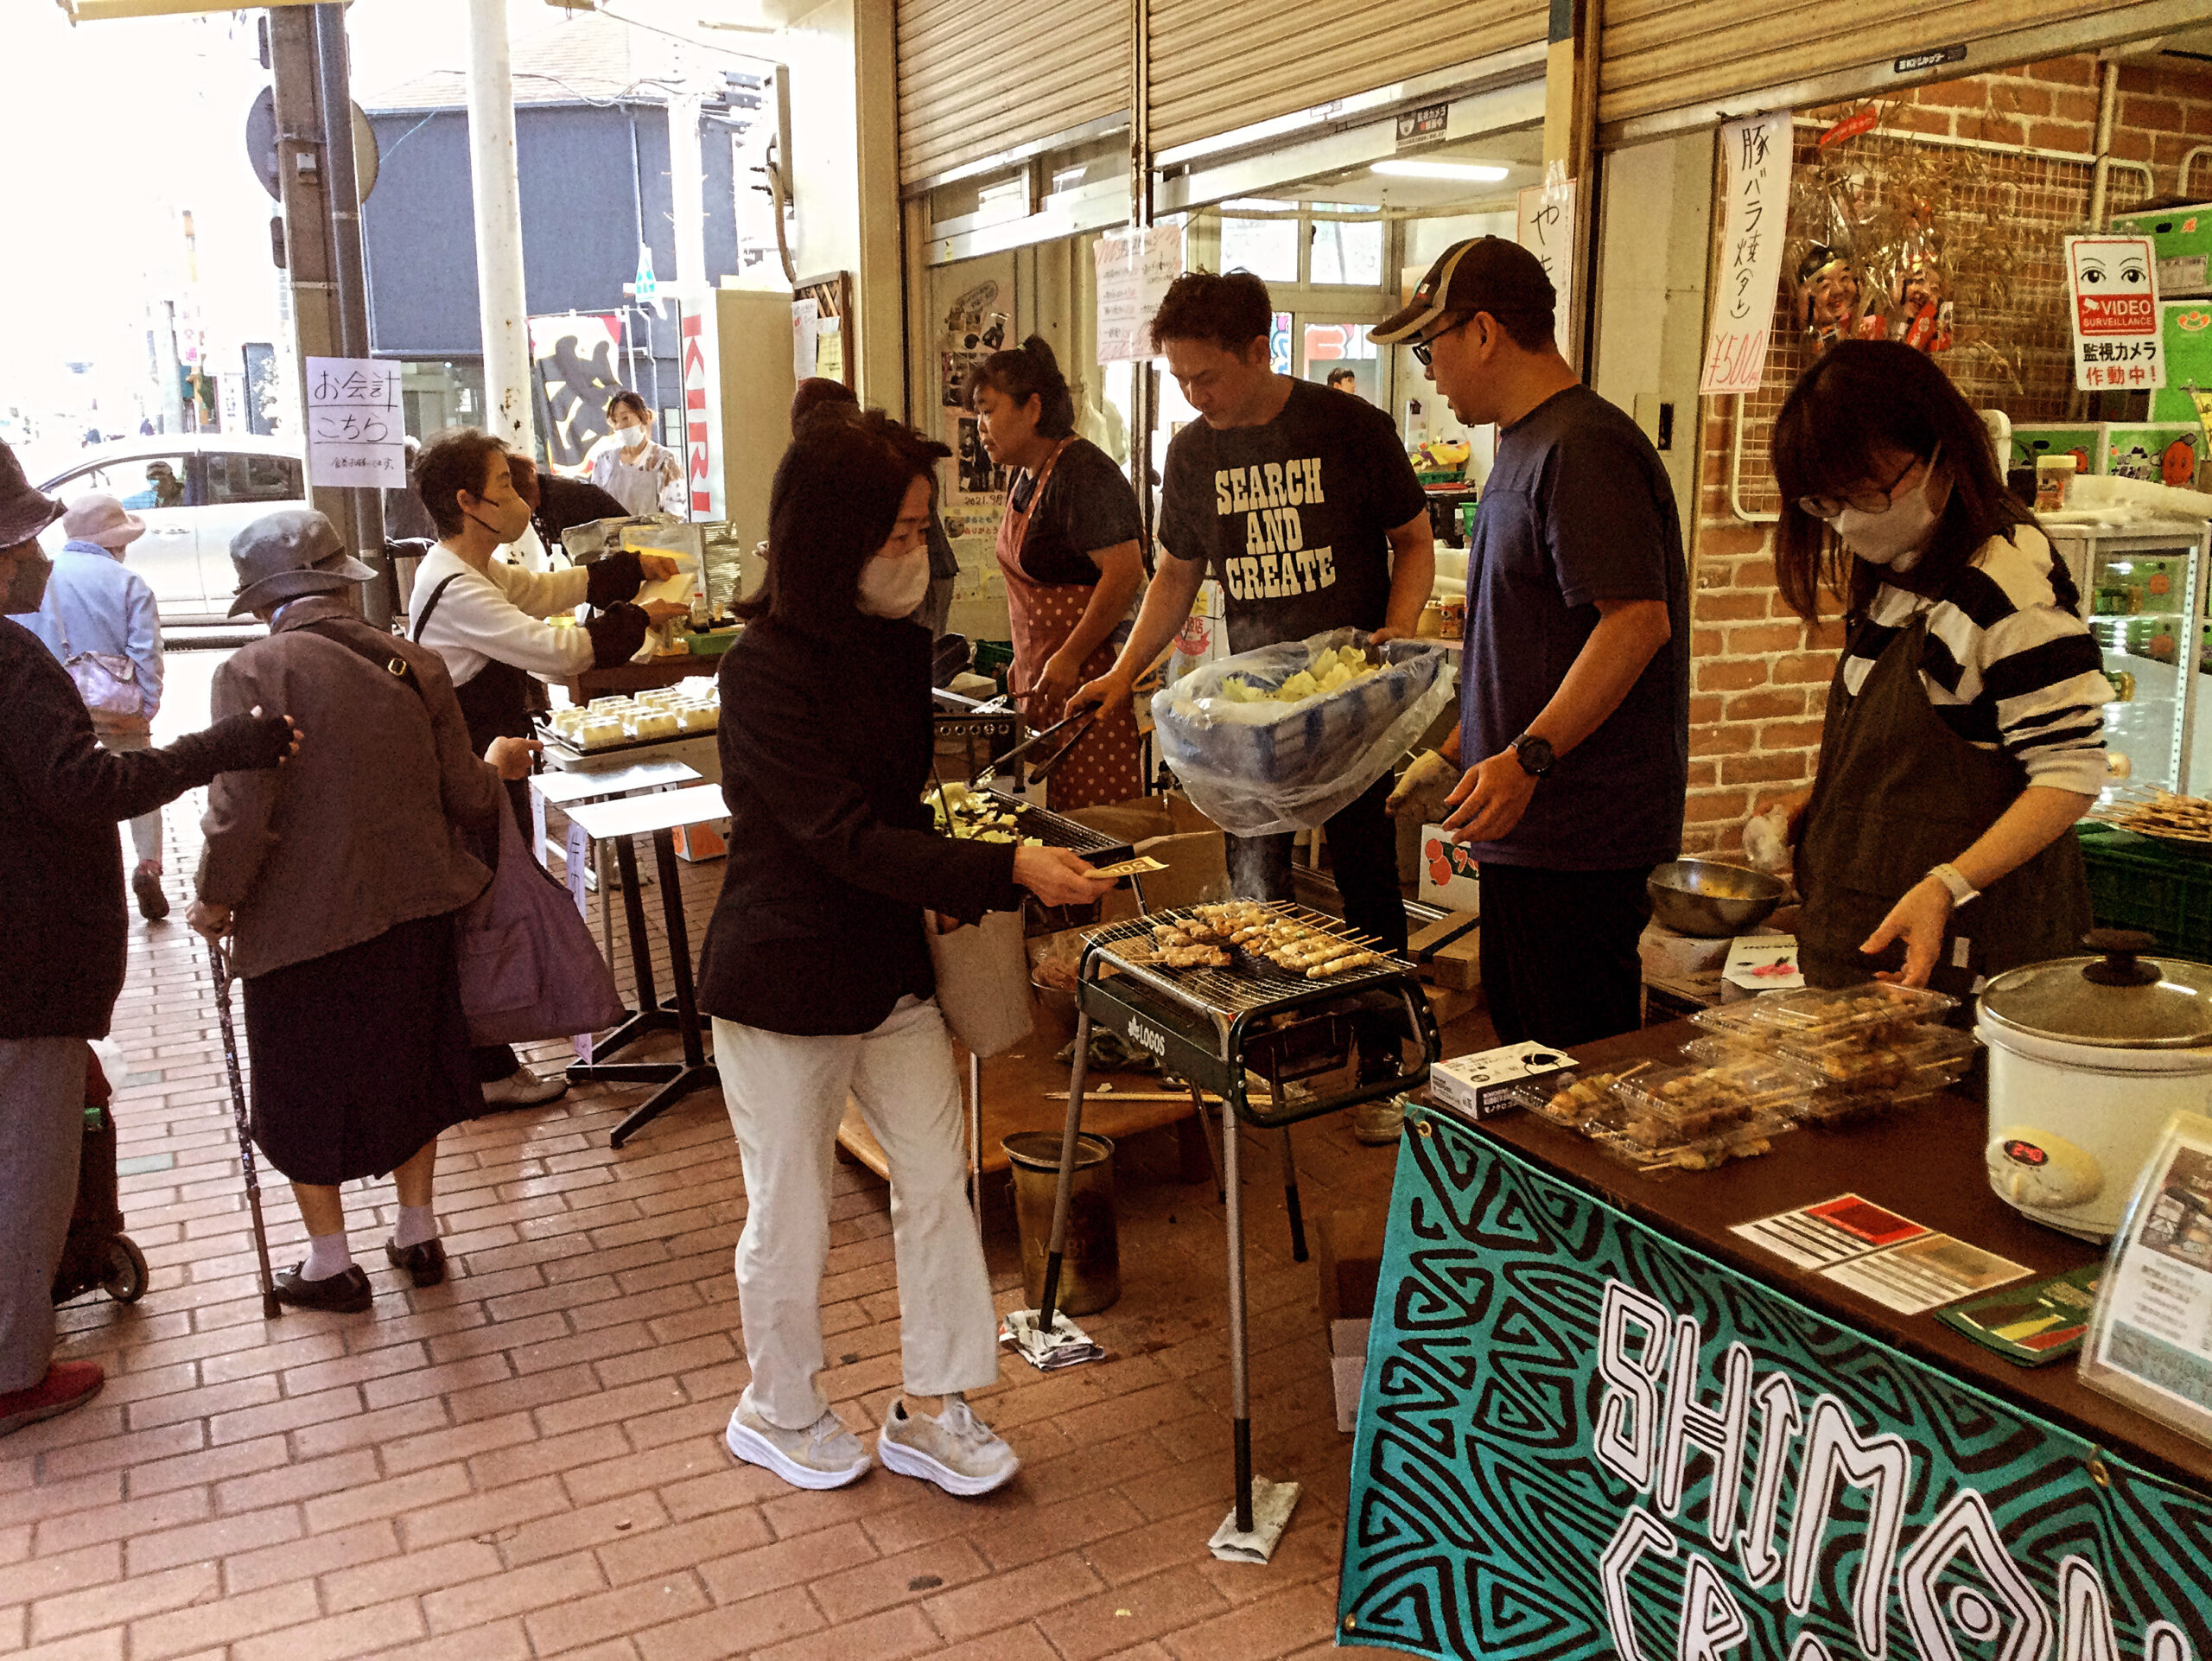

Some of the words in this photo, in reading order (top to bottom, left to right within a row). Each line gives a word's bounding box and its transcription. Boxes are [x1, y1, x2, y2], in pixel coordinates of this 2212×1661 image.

[2083, 316, 2153, 328] SURVEILLANCE
[2101, 300, 2152, 315] VIDEO
[2082, 341, 2157, 362] 監視カメラ
[314, 370, 401, 413] お会計
[2086, 365, 2157, 386] 作動中!
[317, 412, 389, 442] こちら
[683, 314, 711, 513] KIRI
[1215, 457, 1325, 516] SEARCH
[1246, 506, 1304, 556] AND
[1225, 545, 1337, 601] CREATE
[1140, 1023, 1166, 1056] LOGOS
